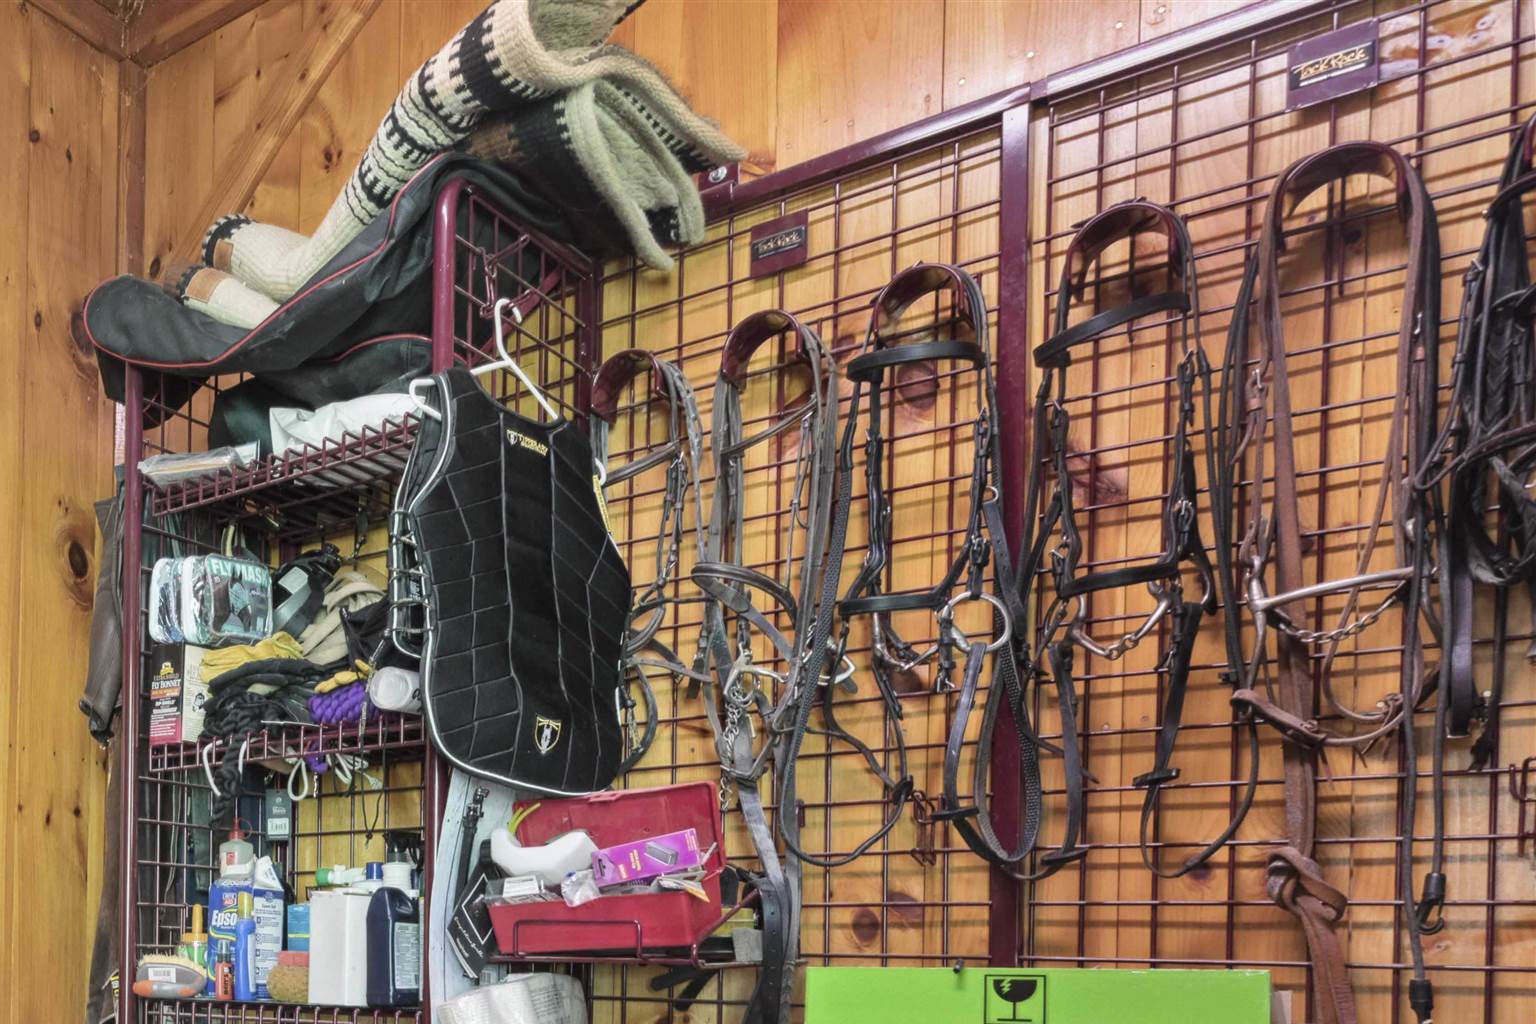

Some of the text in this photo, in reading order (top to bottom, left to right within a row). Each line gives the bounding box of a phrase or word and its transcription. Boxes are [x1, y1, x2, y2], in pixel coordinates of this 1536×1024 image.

[210, 558, 268, 587] FLY MASK
[212, 909, 238, 927] Epso
